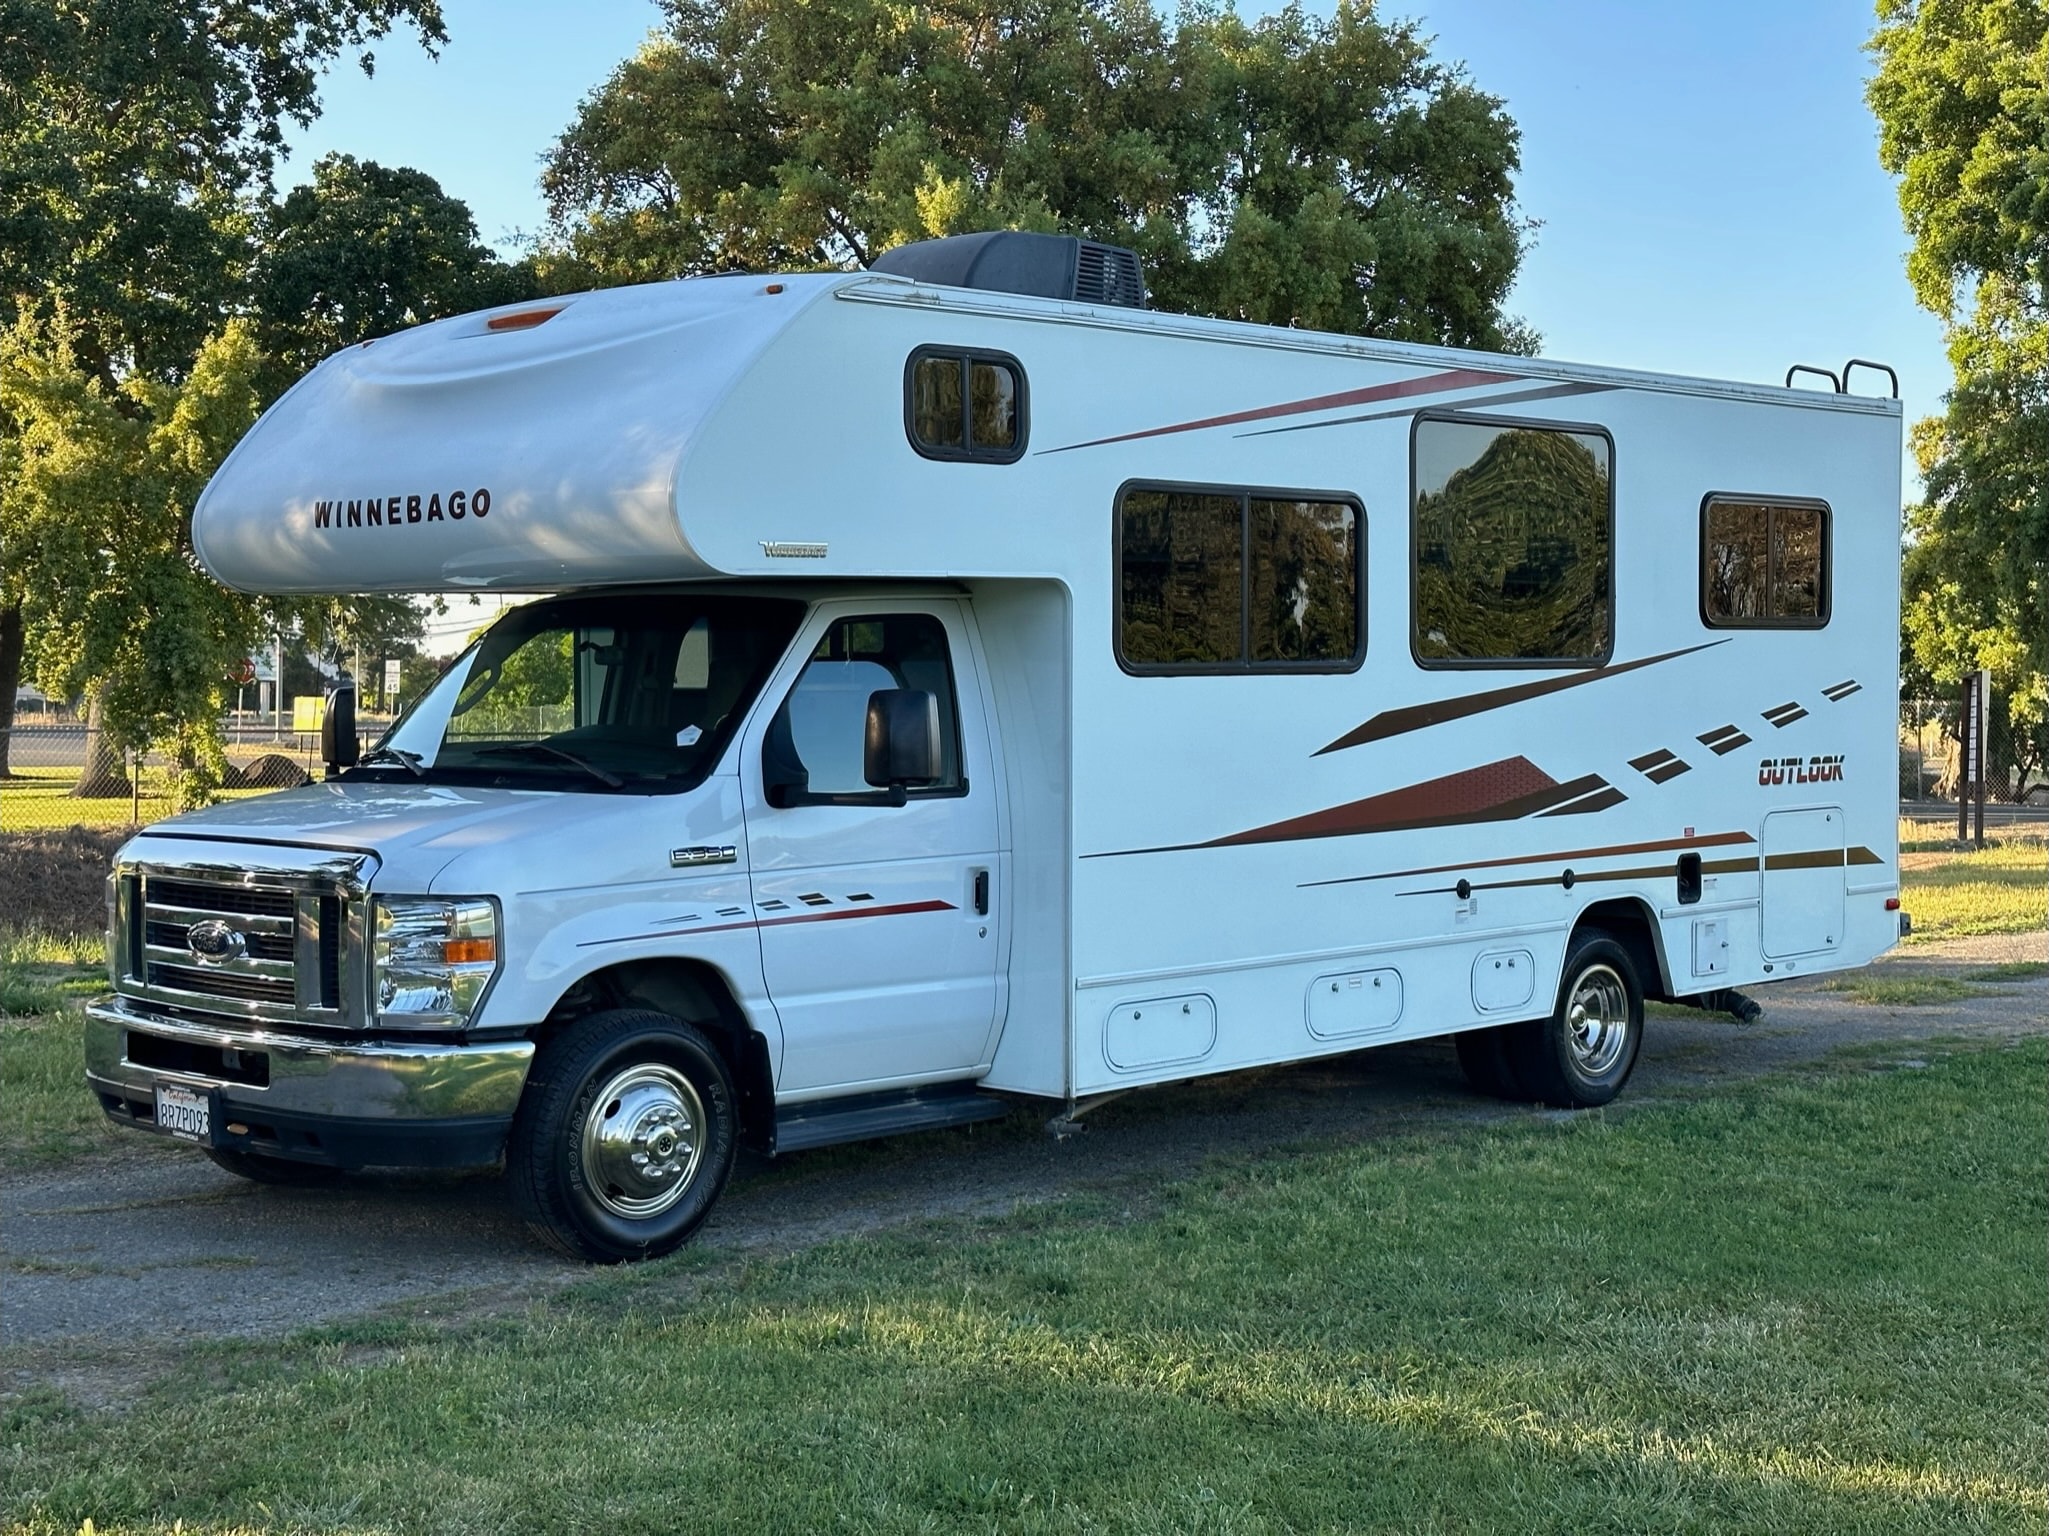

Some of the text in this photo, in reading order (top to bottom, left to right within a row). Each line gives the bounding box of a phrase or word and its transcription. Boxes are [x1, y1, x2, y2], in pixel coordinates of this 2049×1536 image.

[315, 488, 491, 528] WINNEBAGO
[387, 683, 398, 691] 45
[1758, 754, 1845, 785] OUTLOOK
[161, 1103, 211, 1135] 8RZP093
[568, 1079, 598, 1191] IRONMAN
